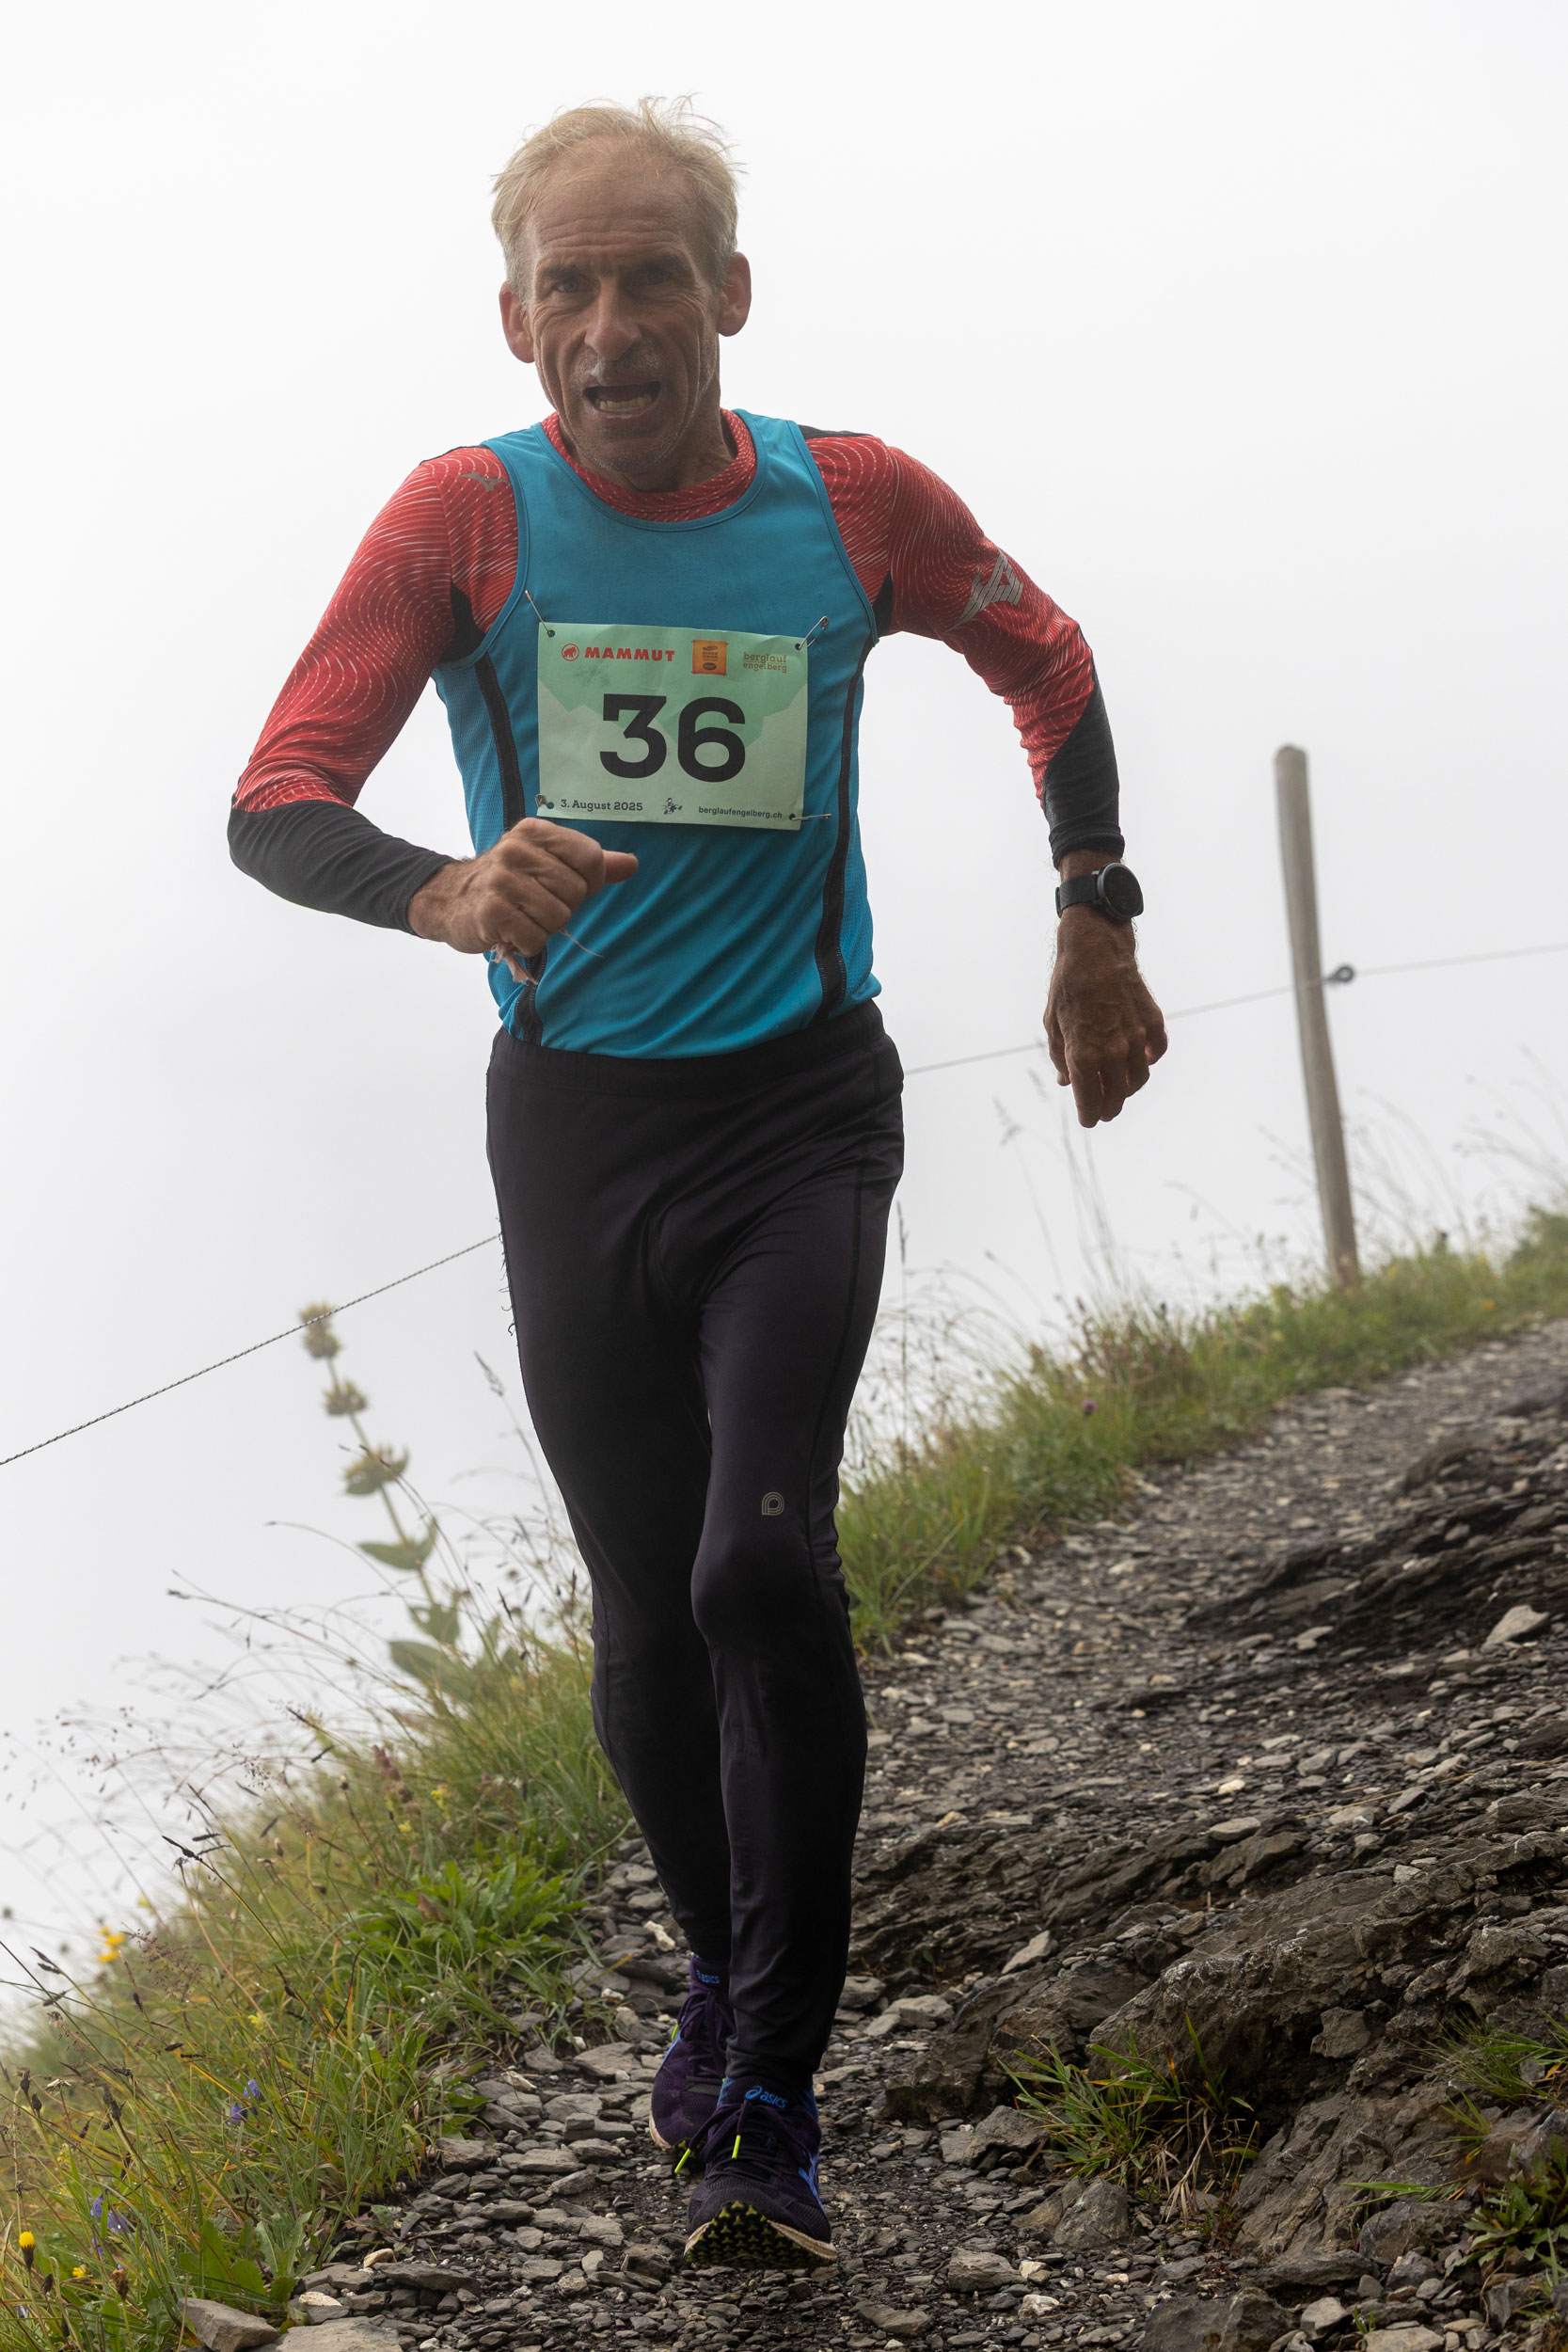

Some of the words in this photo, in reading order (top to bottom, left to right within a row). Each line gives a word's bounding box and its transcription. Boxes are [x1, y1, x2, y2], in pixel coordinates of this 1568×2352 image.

[584, 646, 675, 661] MAMMUT
[743, 651, 787, 664] berglauf
[743, 662, 787, 674] engelberg
[599, 693, 746, 783] 36
[561, 799, 570, 808] 3.
[571, 800, 611, 812] August
[613, 802, 643, 811] 2025
[698, 805, 783, 818] berglaufengelberg.ch
[760, 2091, 787, 2108] asics
